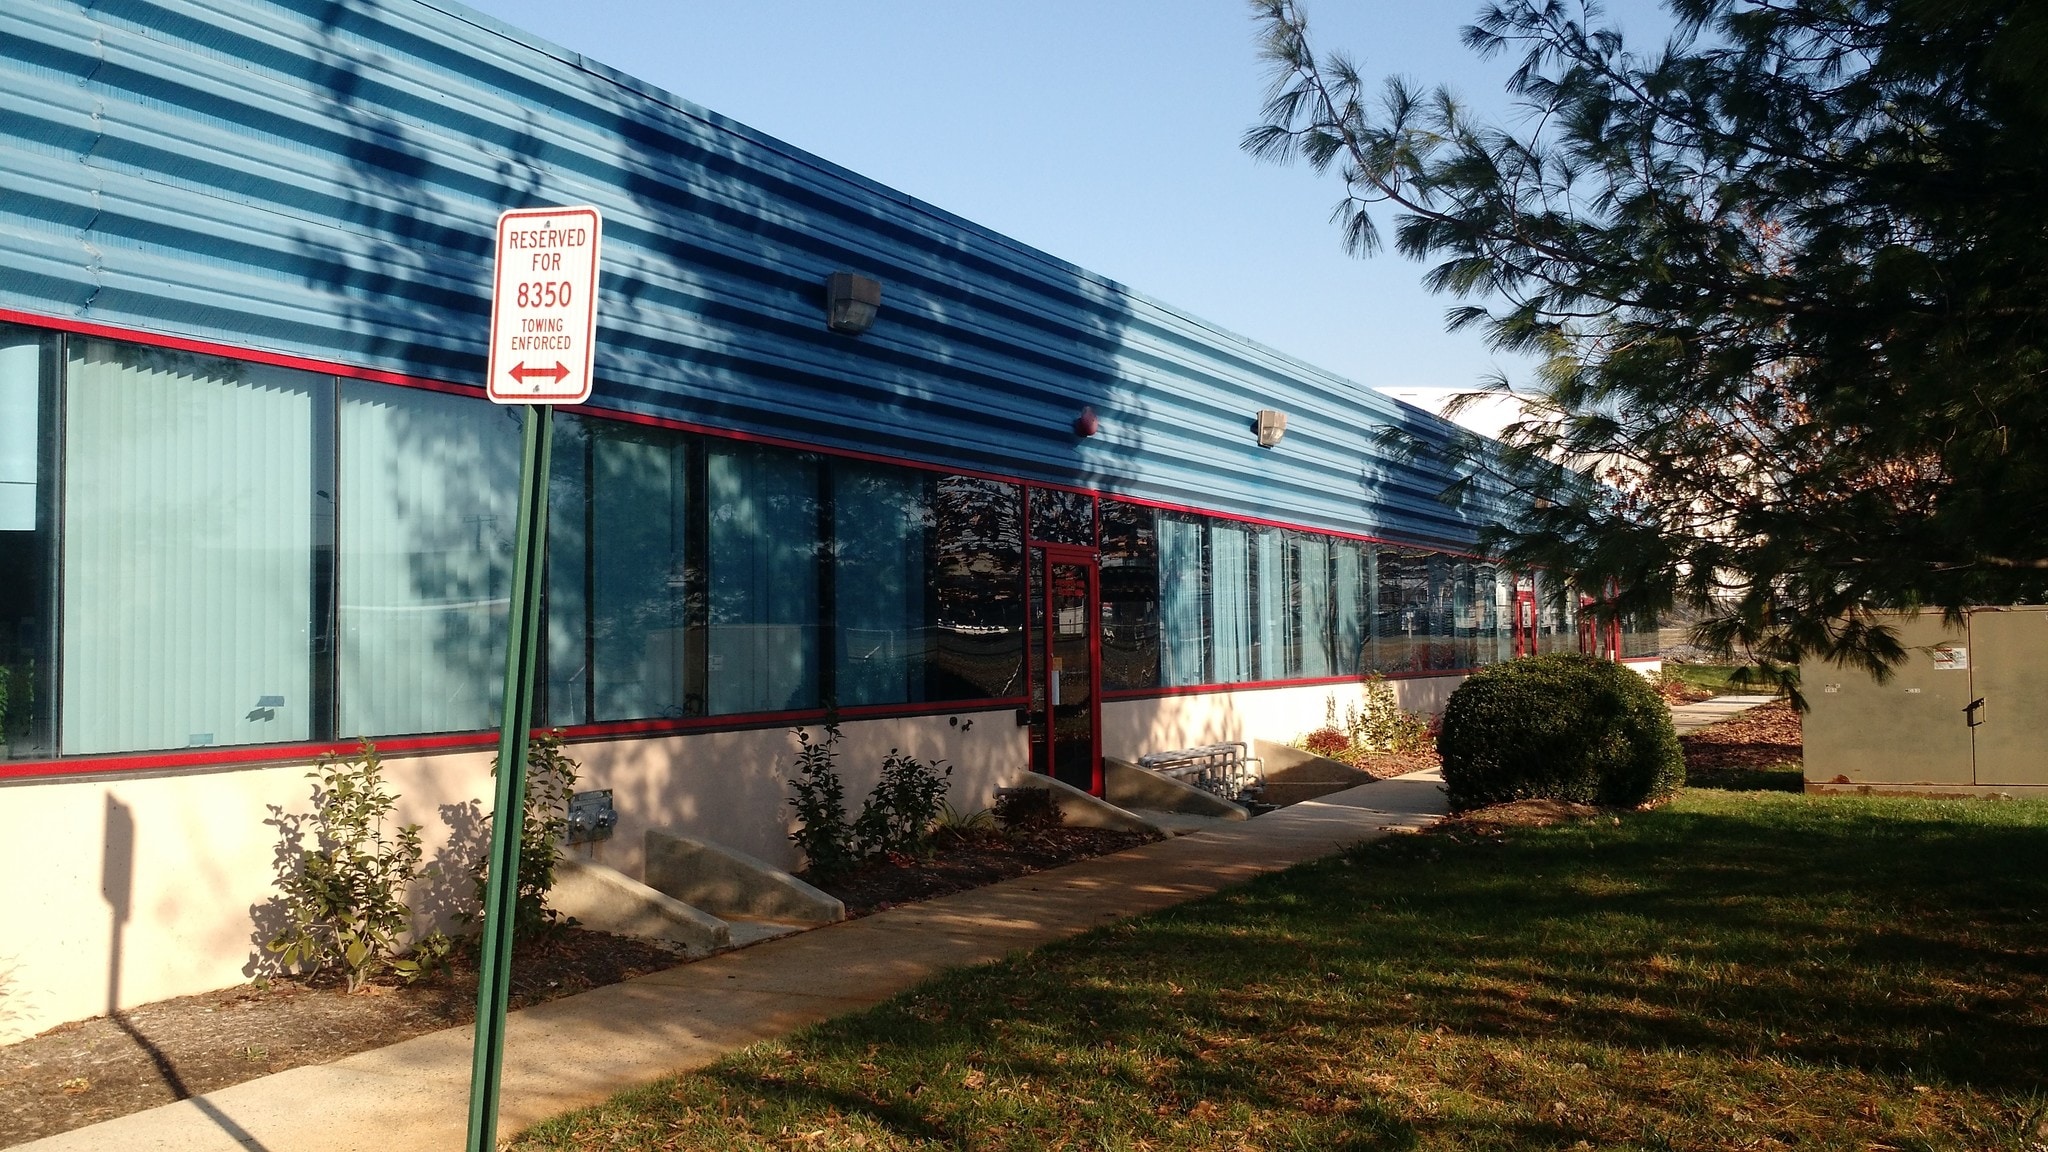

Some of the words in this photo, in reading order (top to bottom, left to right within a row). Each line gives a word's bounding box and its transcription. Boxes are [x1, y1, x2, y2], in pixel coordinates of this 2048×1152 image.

[509, 228, 586, 249] RESERVED
[532, 253, 562, 272] FOR
[517, 281, 572, 308] 8350
[521, 318, 564, 333] TOWING
[511, 335, 571, 350] ENFORCED
